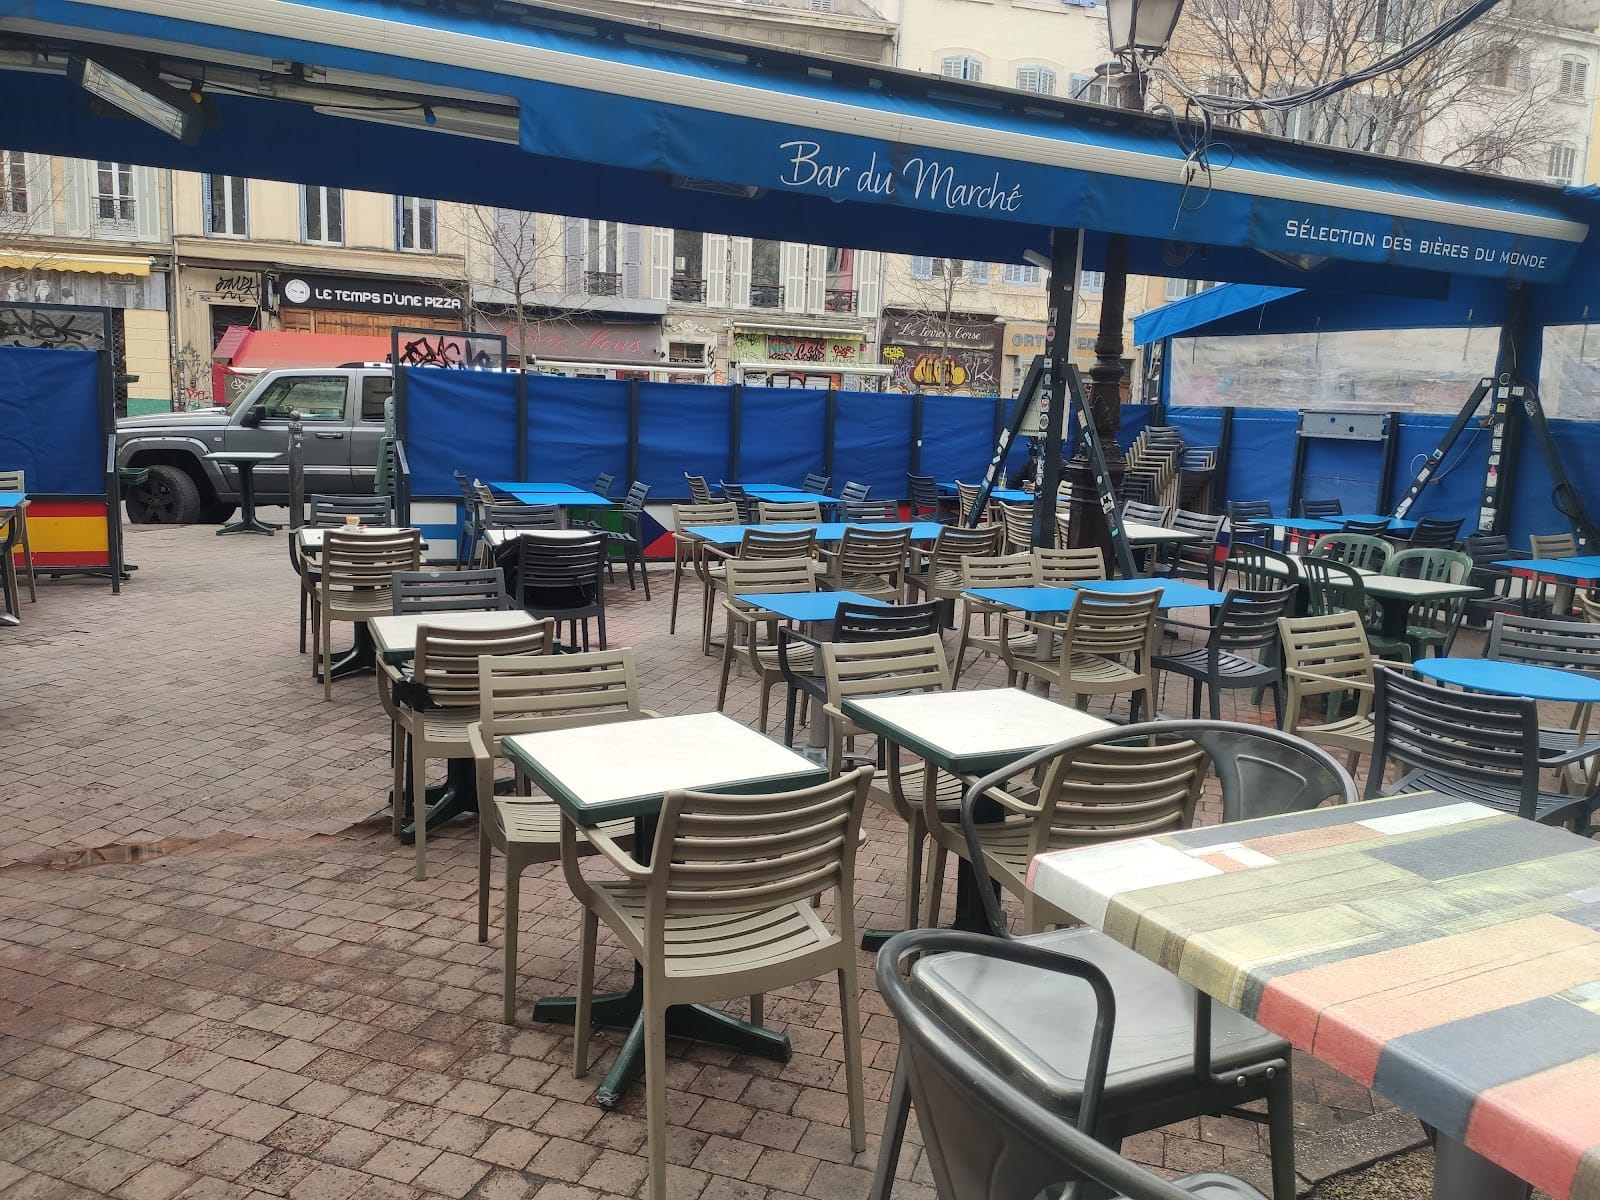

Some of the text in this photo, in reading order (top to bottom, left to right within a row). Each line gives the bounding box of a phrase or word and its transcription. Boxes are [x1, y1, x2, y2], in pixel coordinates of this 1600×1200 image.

[779, 141, 1023, 212] Bar du Marché
[1285, 218, 1547, 269] SÉLECTION DES BIÈRES DU MONDE
[315, 288, 461, 309] LE TEMPS D'UNE PIZZA
